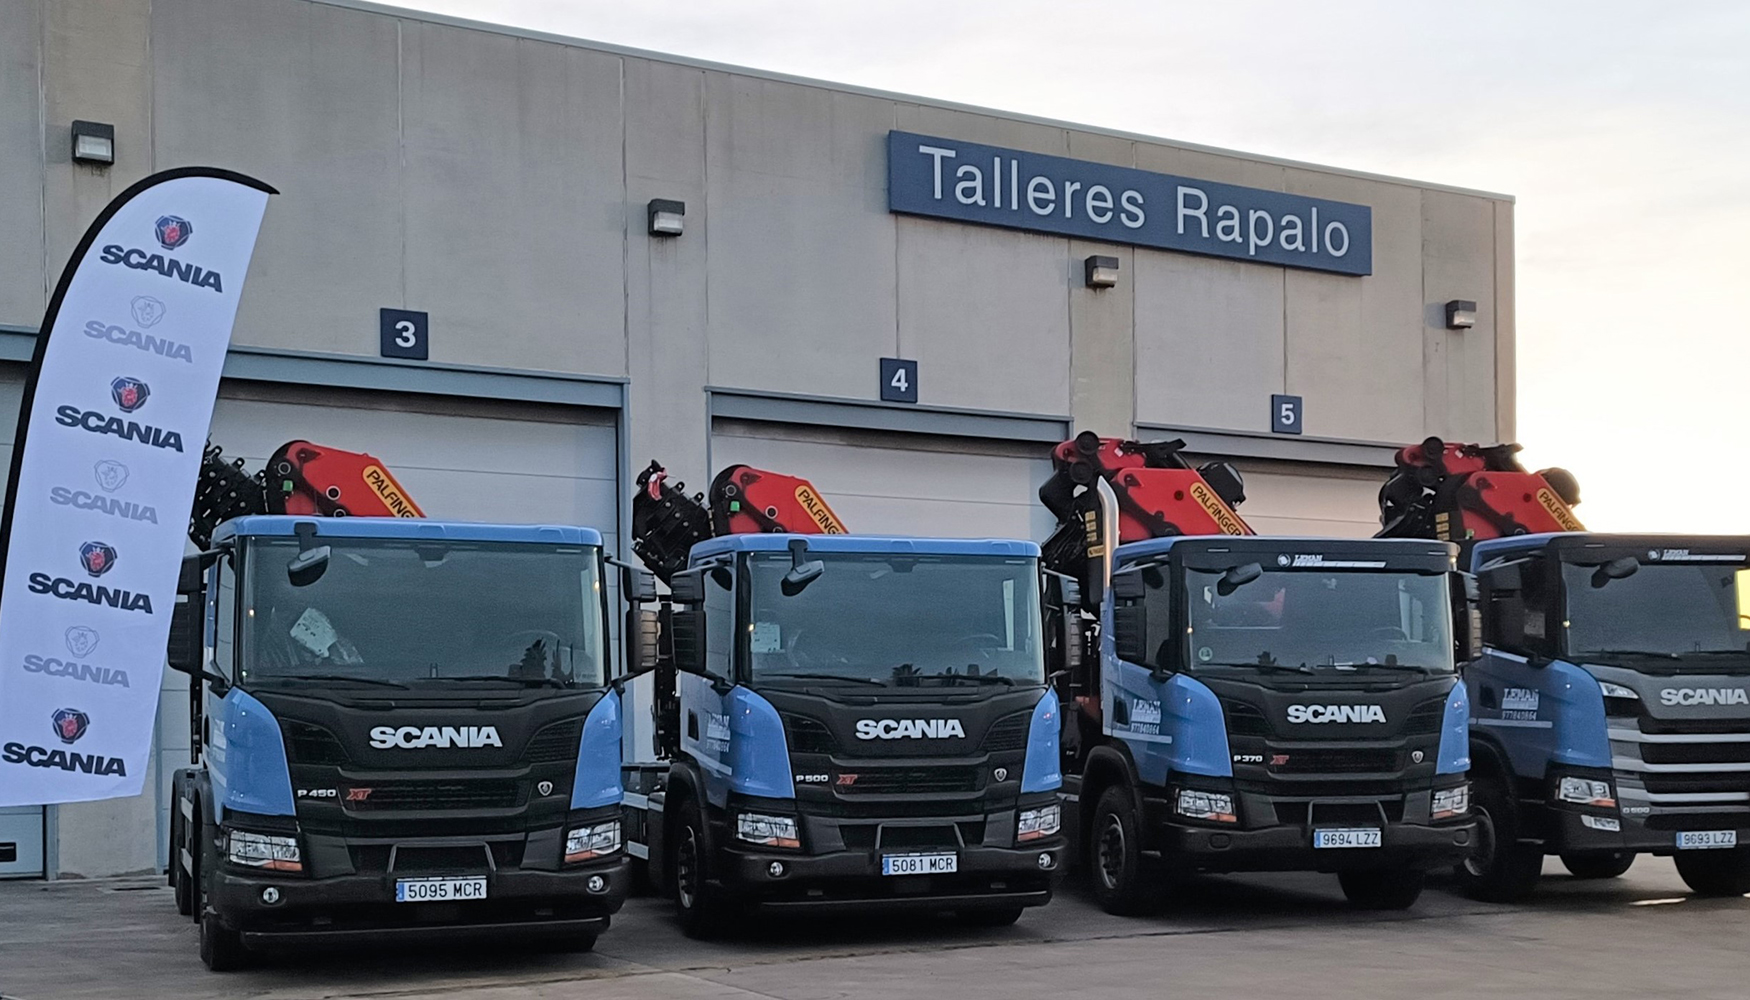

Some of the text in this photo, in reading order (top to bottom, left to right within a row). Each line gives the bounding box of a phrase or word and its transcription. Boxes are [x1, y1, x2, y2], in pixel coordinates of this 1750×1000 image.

[919, 144, 1349, 257] Talleres Rapalo
[100, 245, 222, 293] SCANIA
[83, 320, 193, 363] SCANIA
[395, 320, 416, 348] 3
[891, 368, 908, 392] 4
[1281, 403, 1295, 425] 5
[55, 405, 184, 453] SCANIA
[50, 487, 158, 525] SCANIA
[798, 489, 841, 535] PALFING
[28, 572, 153, 614] SCANIA
[23, 654, 130, 688] SCANIA
[1660, 688, 1749, 706] SCANIA
[1287, 704, 1387, 724] SCANIA
[369, 726, 503, 749] SCANIA
[855, 719, 966, 740] SCANIA
[2, 742, 127, 777] SCANIA
[836, 774, 858, 785] XT
[297, 789, 337, 797] P 450
[346, 788, 373, 800] XT
[1323, 832, 1378, 846] 9694 LZZ
[1684, 832, 1734, 845] 9693 LZZ
[892, 857, 953, 872] 5081 MCR
[408, 882, 482, 899] 5095 MCR
